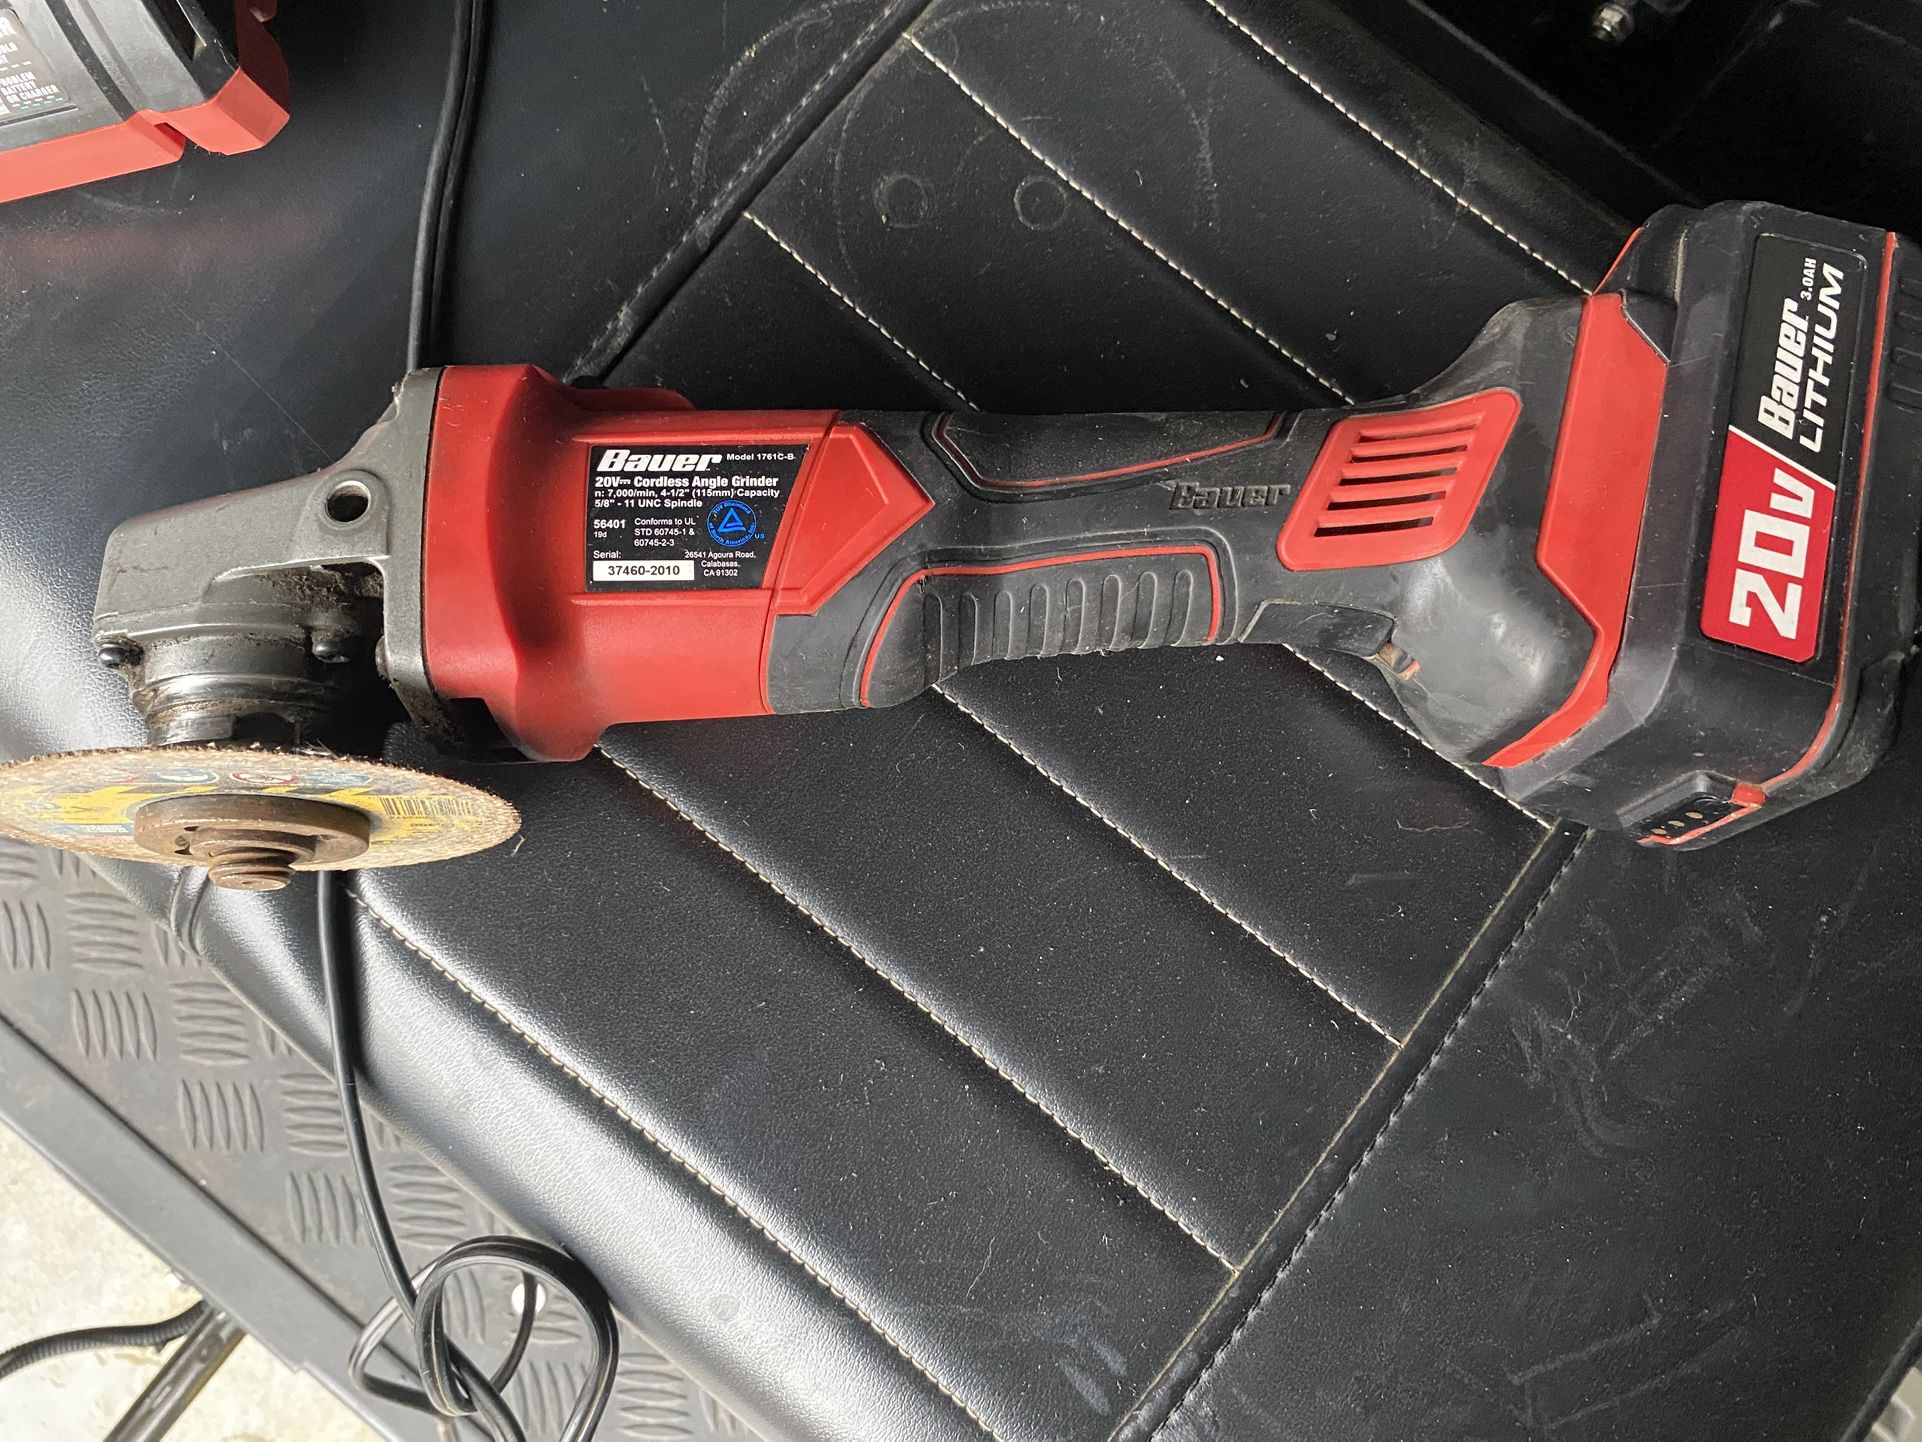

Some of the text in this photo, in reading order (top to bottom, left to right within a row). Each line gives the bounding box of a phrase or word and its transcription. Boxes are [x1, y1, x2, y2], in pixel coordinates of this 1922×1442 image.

[0, 80, 37, 96] BATTERY
[19, 84, 60, 101] CHARGER
[1800, 257, 1817, 301] 3.0AH
[1800, 262, 1844, 453] LITHIUM
[1758, 297, 1808, 440] Bauer
[597, 449, 723, 472] Bauer
[726, 453, 755, 461] Model
[633, 475, 690, 488] Cordless
[691, 475, 729, 490] Angle
[731, 475, 779, 488] Grinder
[594, 488, 605, 498] n:
[607, 488, 658, 499] 7,000/min,
[691, 488, 735, 499] (115mm)
[736, 488, 780, 499] Capacity
[1168, 482, 1291, 510] Bauer
[594, 499, 615, 508] 5/8"
[623, 499, 635, 508] 11
[637, 499, 662, 508] UNC
[663, 499, 703, 510] Spindle
[593, 518, 627, 530] 56401
[634, 517, 697, 526] Conforms to UL
[634, 527, 696, 536] STD 60745-1 &
[634, 538, 675, 547] 60745-2-3
[593, 550, 622, 559] Serial:
[684, 550, 707, 559] 26541
[708, 550, 734, 560] Agoura
[607, 565, 681, 576] 37460-2010
[703, 569, 739, 577] CA 91302
